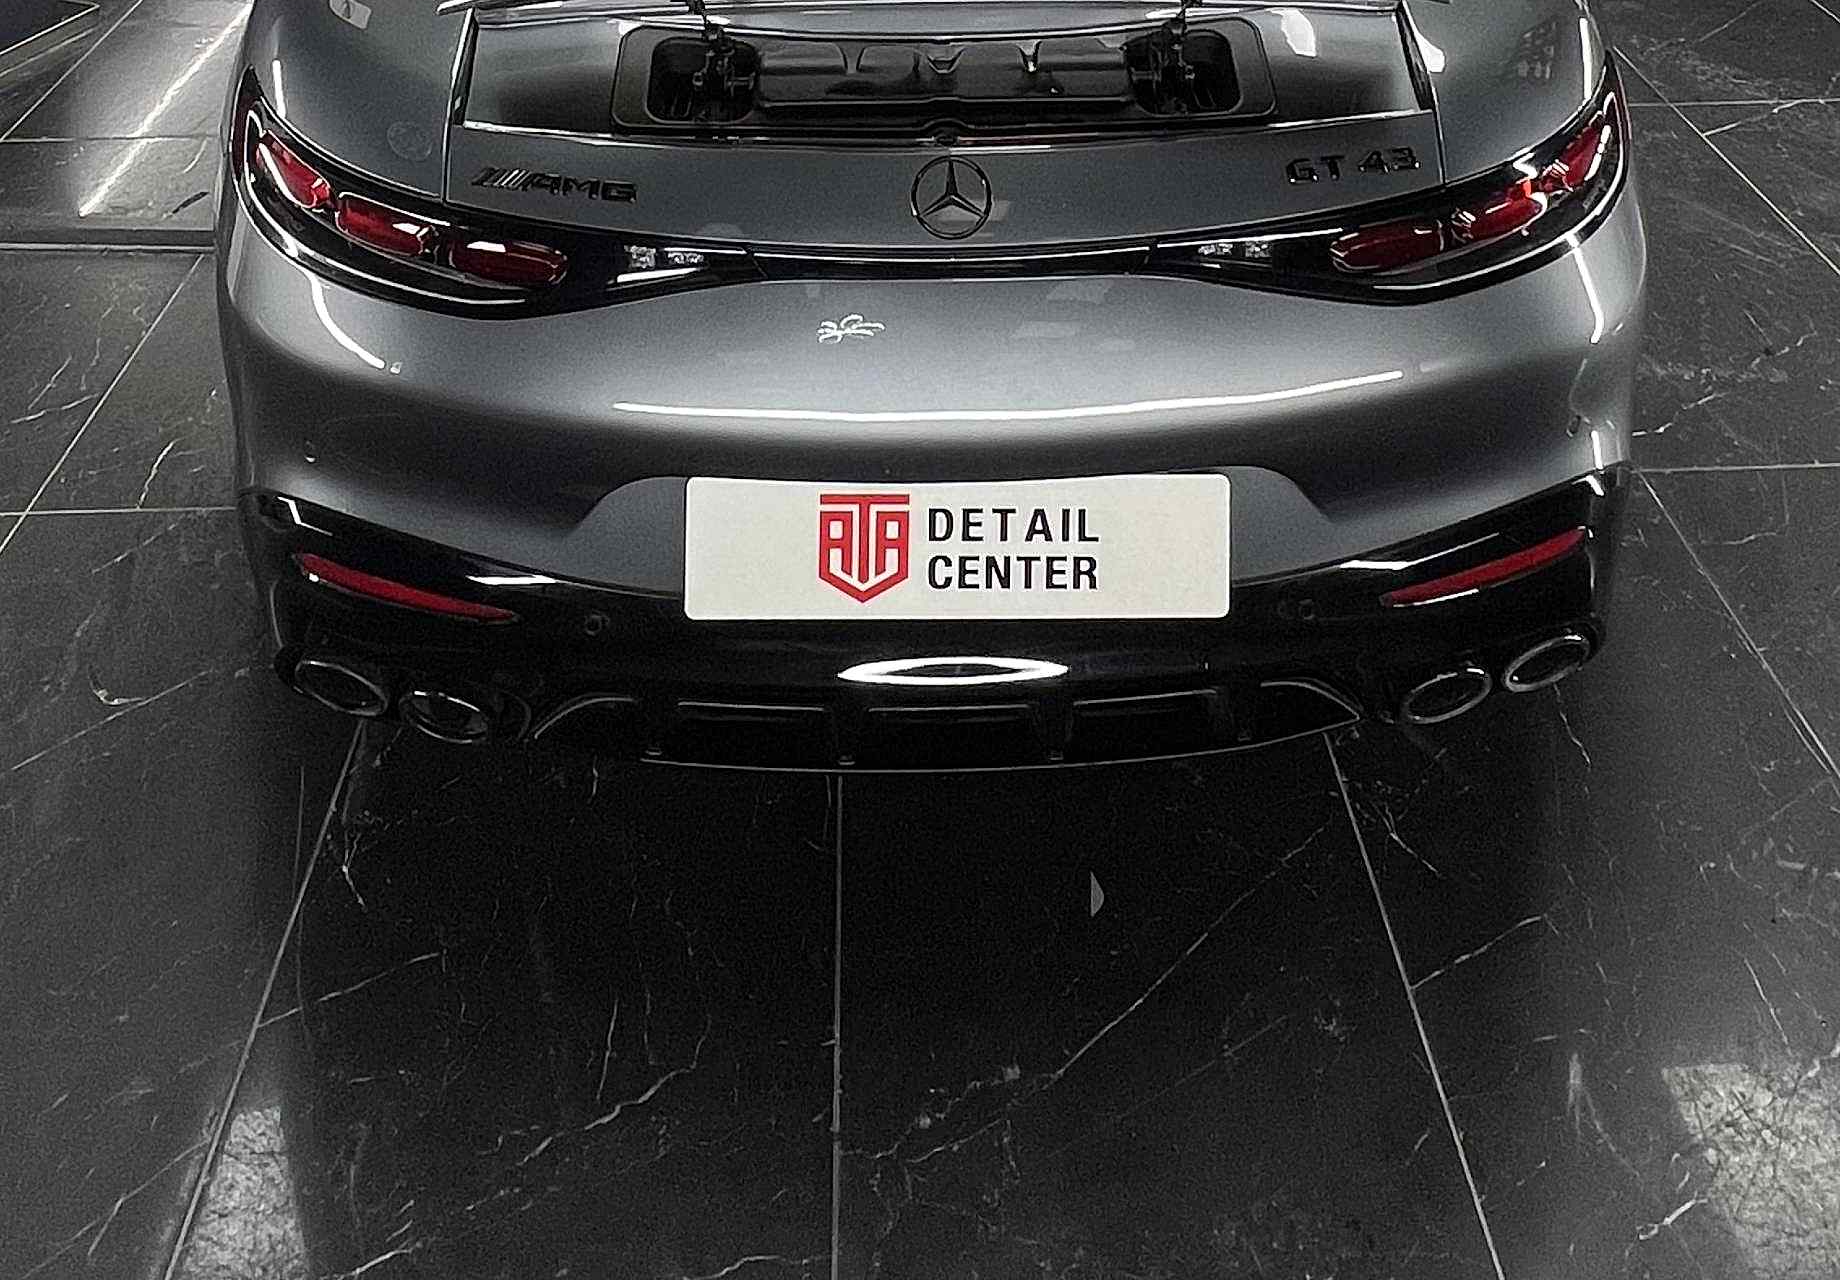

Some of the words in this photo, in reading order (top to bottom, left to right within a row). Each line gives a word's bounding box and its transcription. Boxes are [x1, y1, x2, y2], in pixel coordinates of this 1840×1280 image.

[1286, 154, 1345, 184] GT
[1358, 146, 1422, 173] 43
[927, 507, 1100, 543] DETAIL
[927, 554, 1099, 591] CENTER
